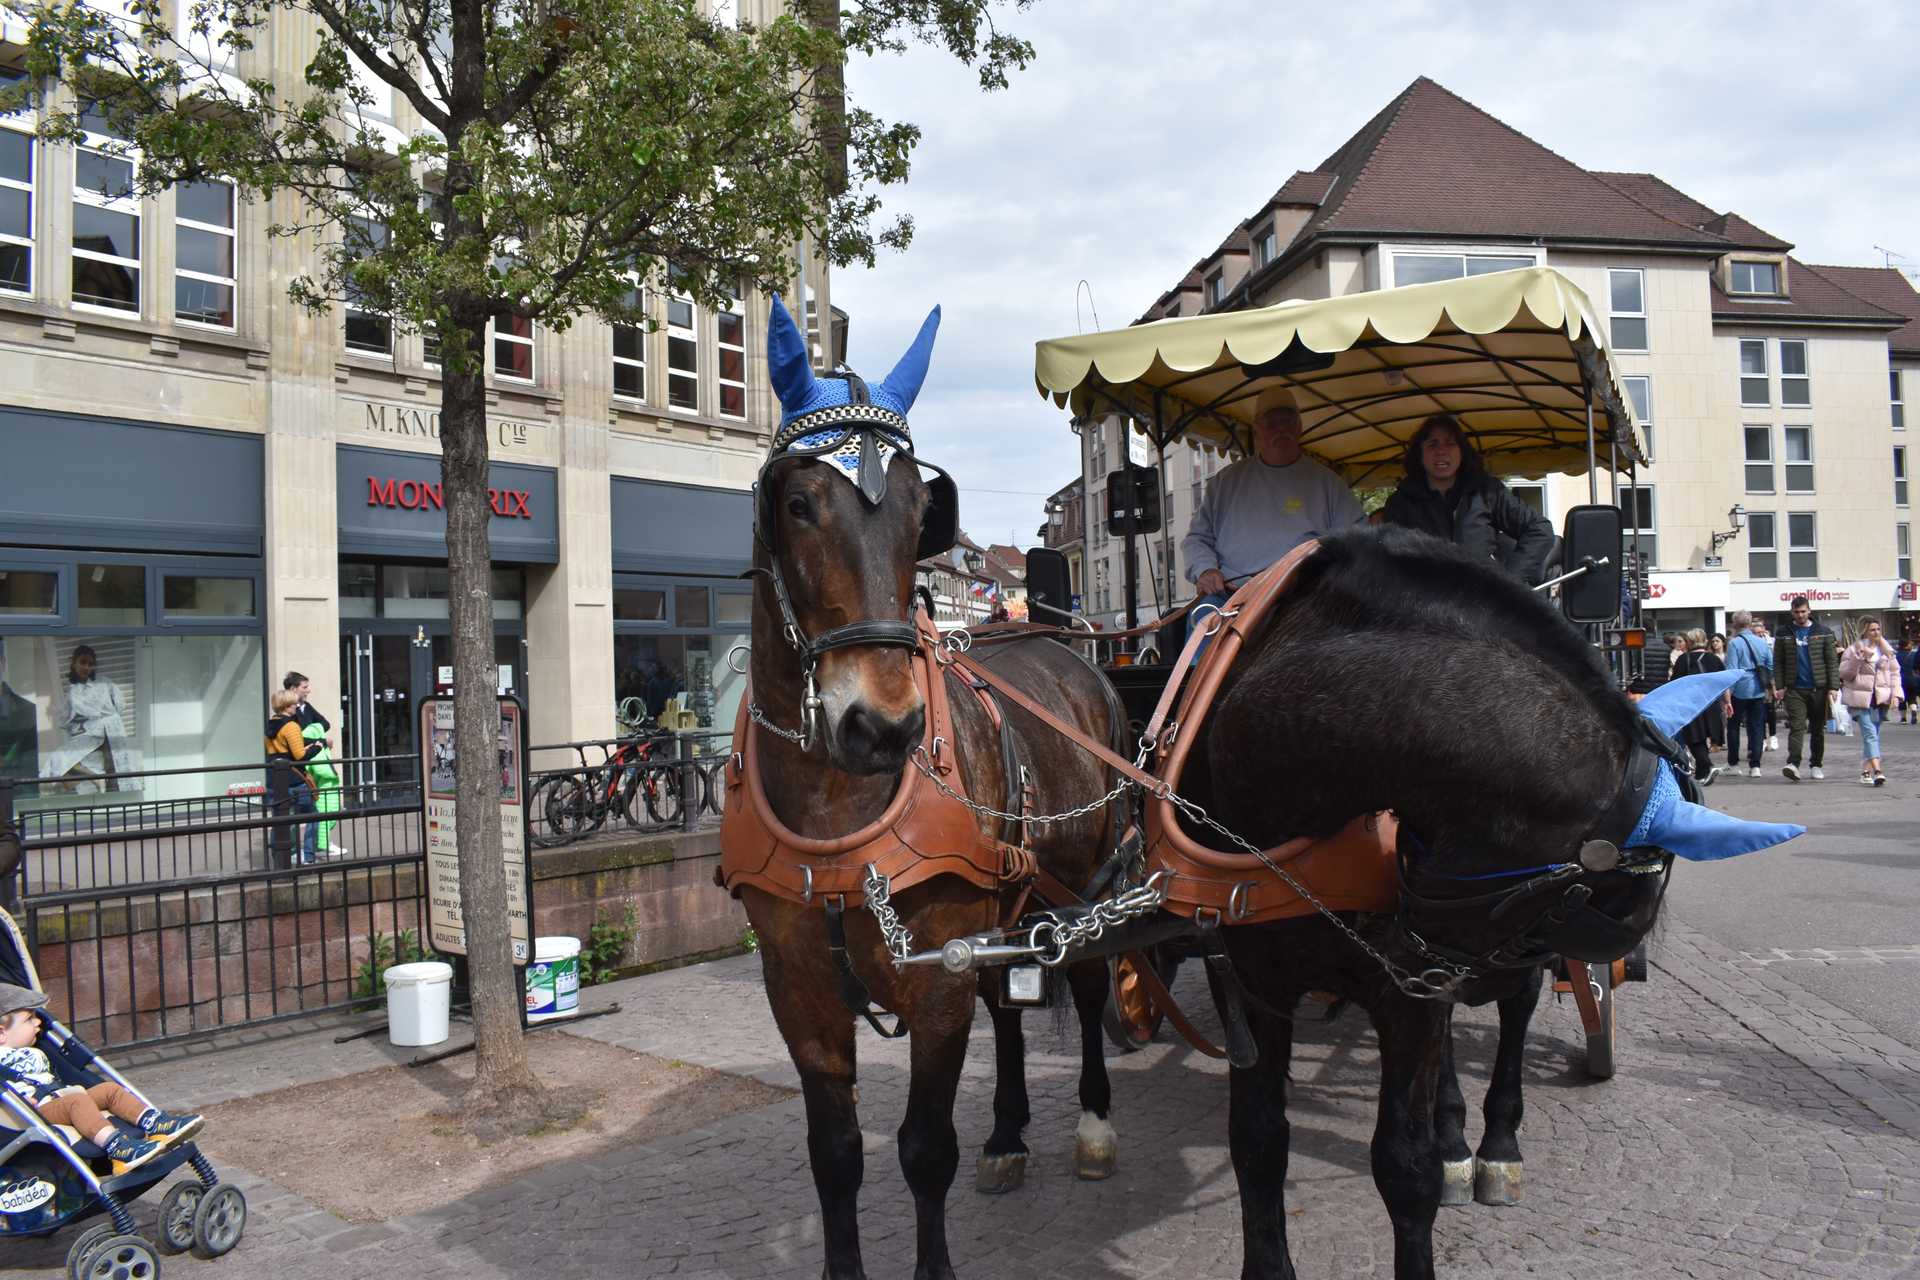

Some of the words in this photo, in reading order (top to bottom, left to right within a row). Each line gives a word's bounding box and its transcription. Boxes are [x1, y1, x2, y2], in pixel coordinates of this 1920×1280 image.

[366, 404, 441, 438] M.KNO
[367, 476, 533, 519] MONRIX
[1, 1184, 50, 1209] babidéal
